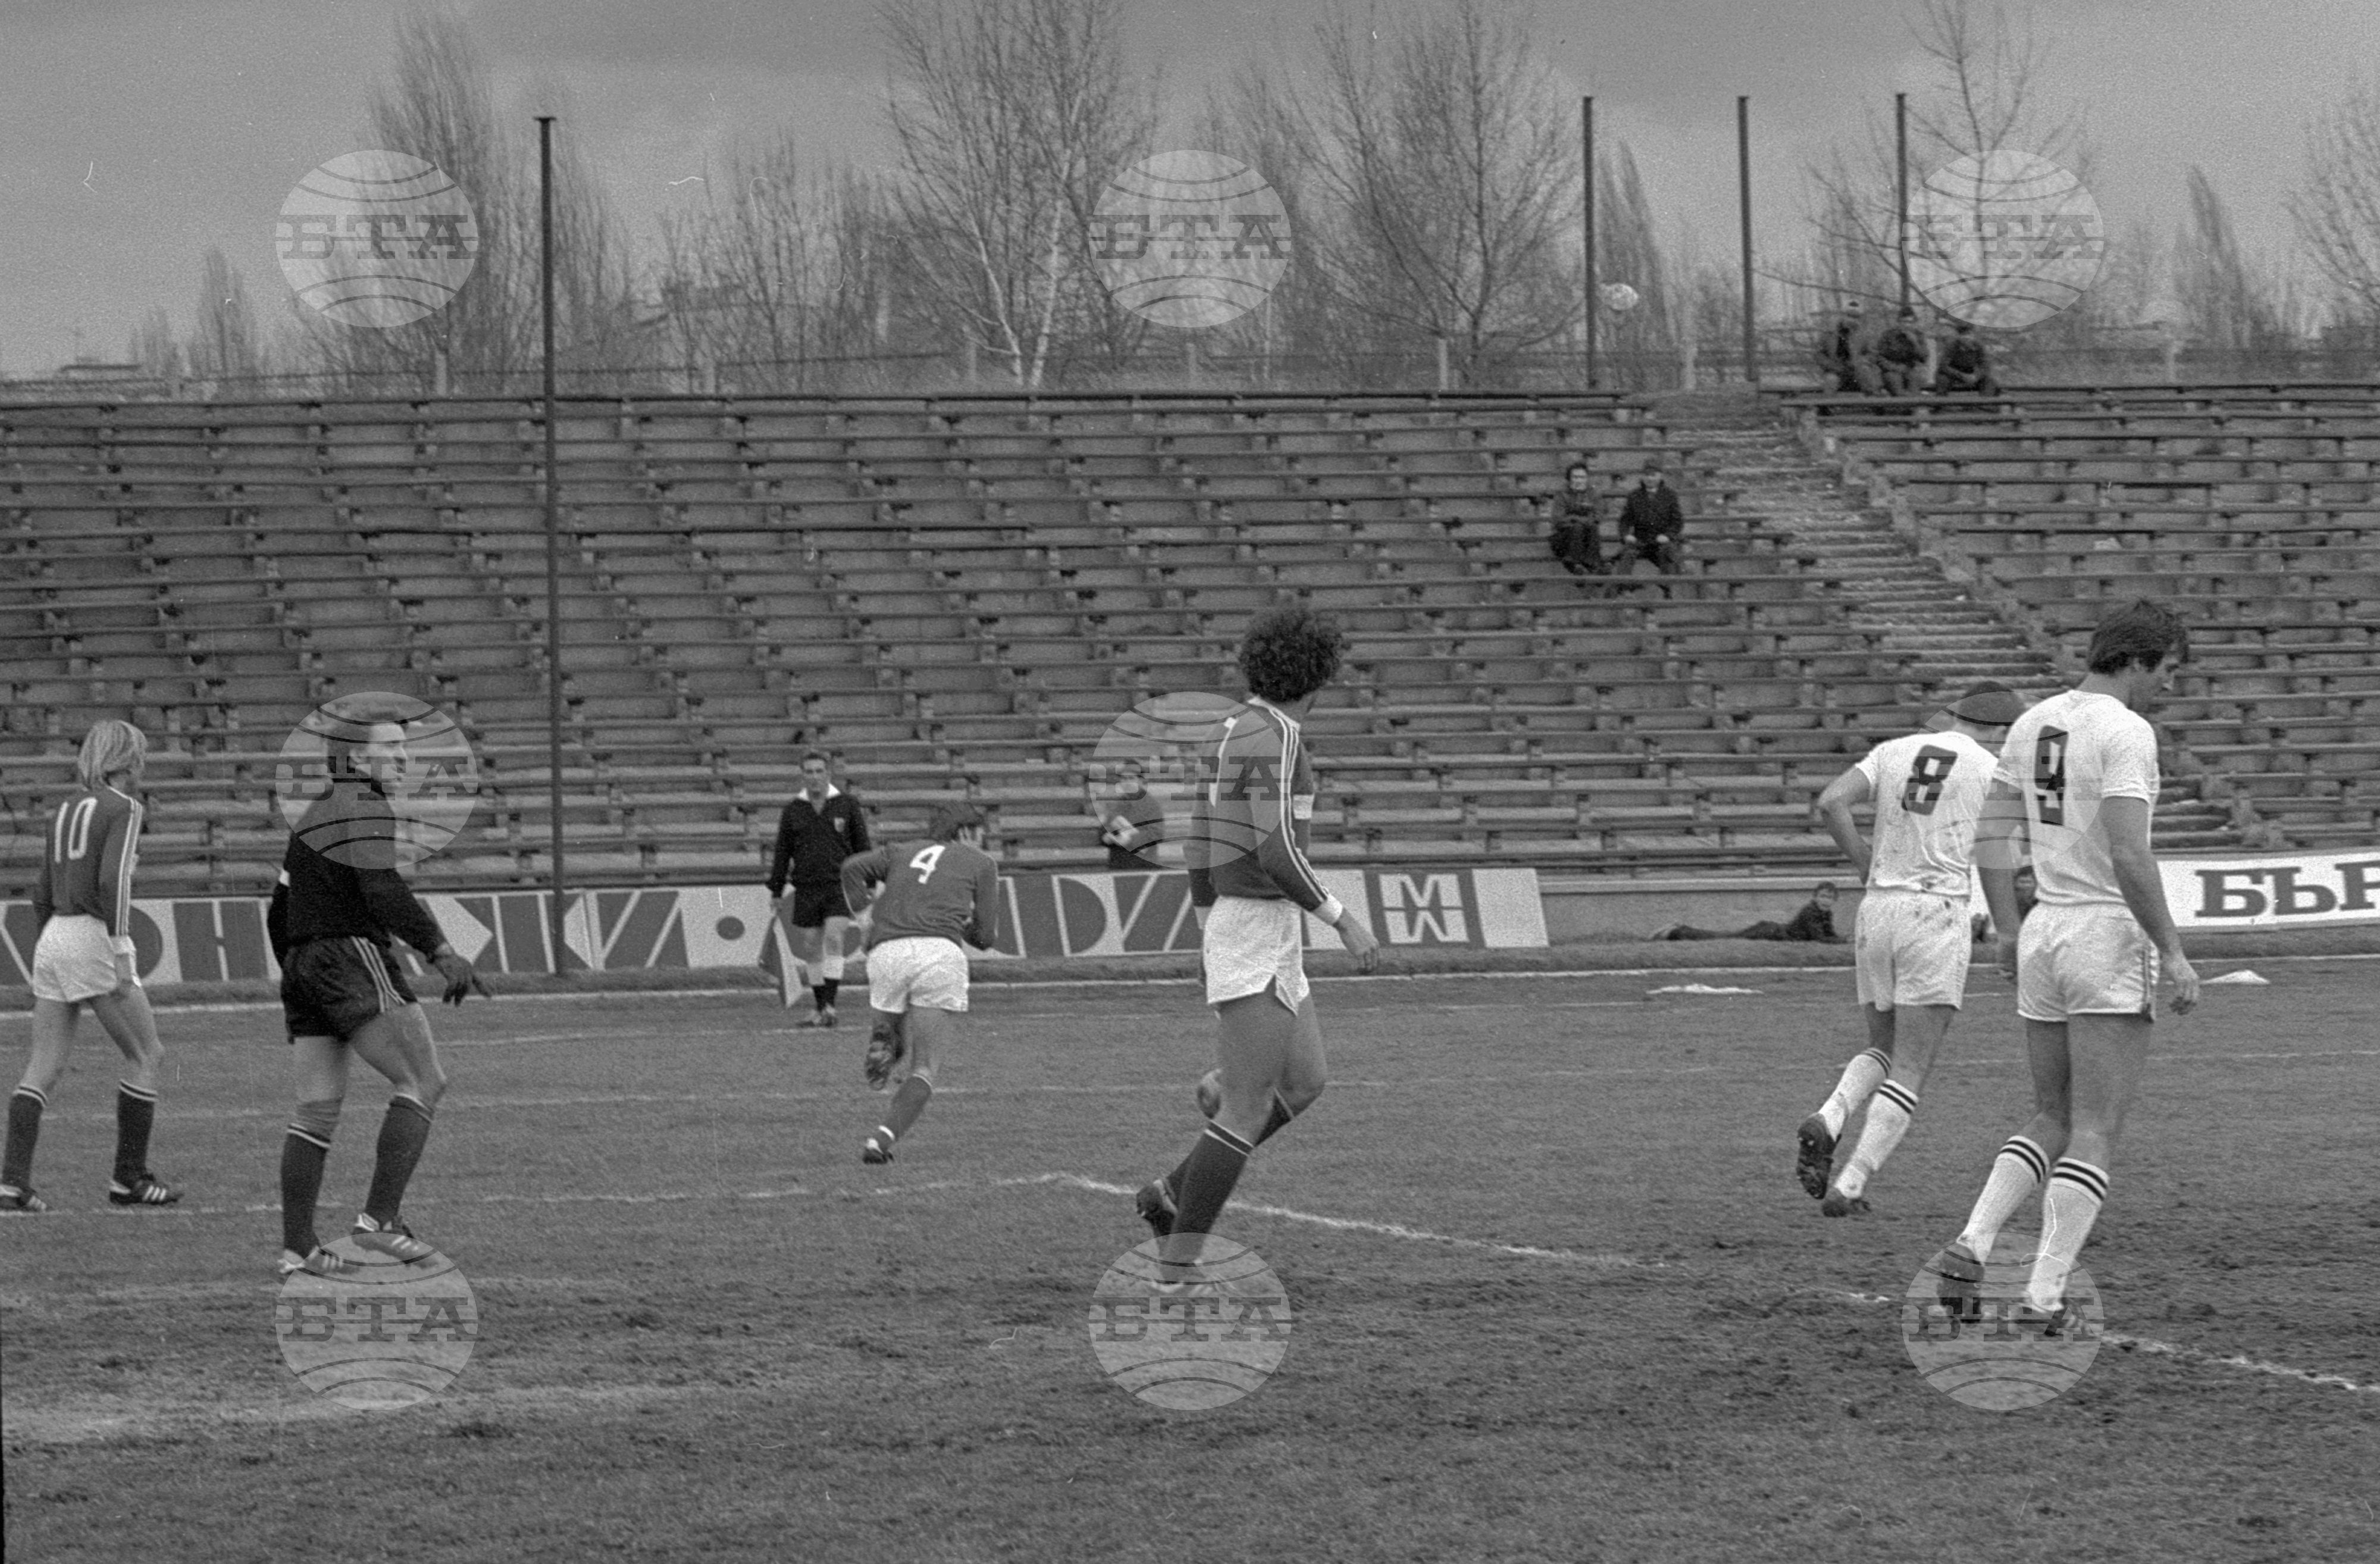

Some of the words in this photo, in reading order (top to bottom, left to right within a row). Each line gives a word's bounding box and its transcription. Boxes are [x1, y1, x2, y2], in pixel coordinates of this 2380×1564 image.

[1901, 745, 1958, 816] 8
[2034, 725, 2069, 825] 9
[55, 797, 98, 862] 10
[910, 844, 945, 884] 4
